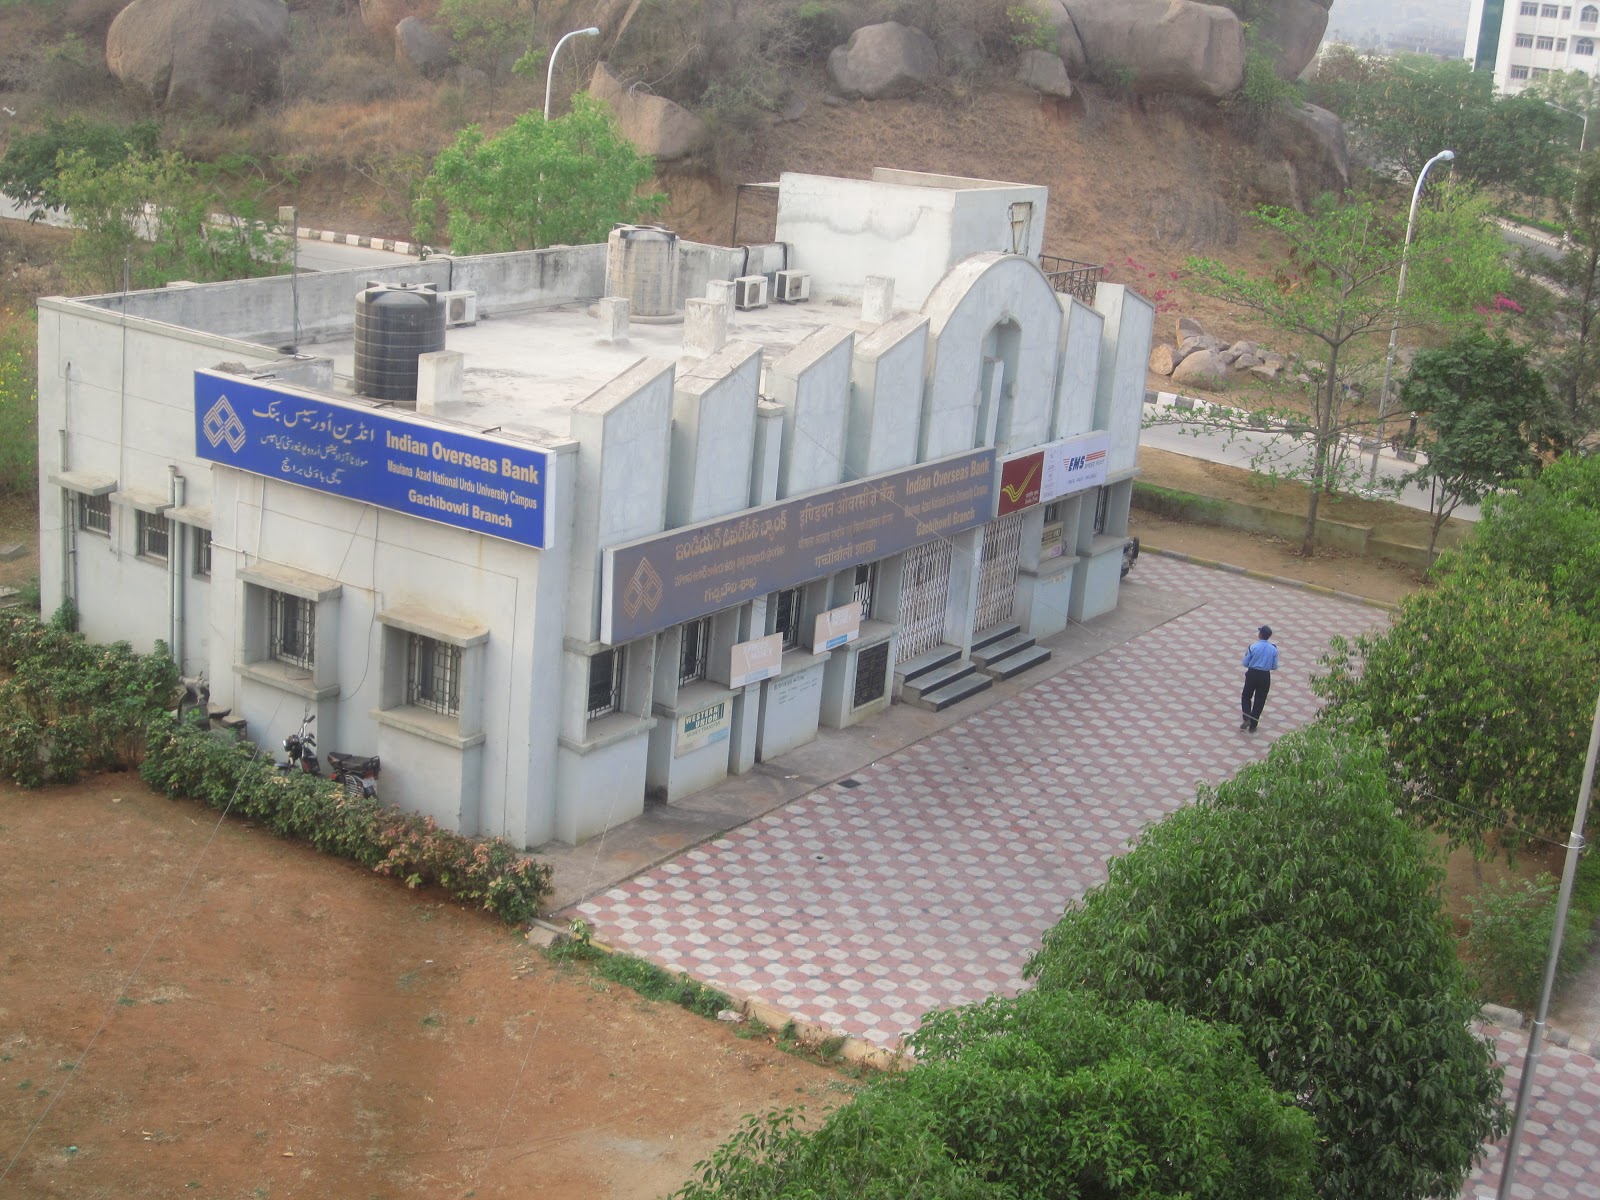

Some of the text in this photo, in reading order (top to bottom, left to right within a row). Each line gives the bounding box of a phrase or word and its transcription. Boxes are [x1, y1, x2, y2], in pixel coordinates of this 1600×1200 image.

[386, 430, 539, 485] Indian Overseas Bank
[1067, 455, 1086, 472] EMS
[387, 459, 537, 510] Maulana Azad National Urdu University Campus
[905, 457, 990, 496] Indian Overseas Bank
[408, 489, 513, 528] Gachibowli Branch
[952, 507, 975, 524] Branch
[685, 705, 719, 724] WESTERN
[695, 713, 718, 729] UNION
